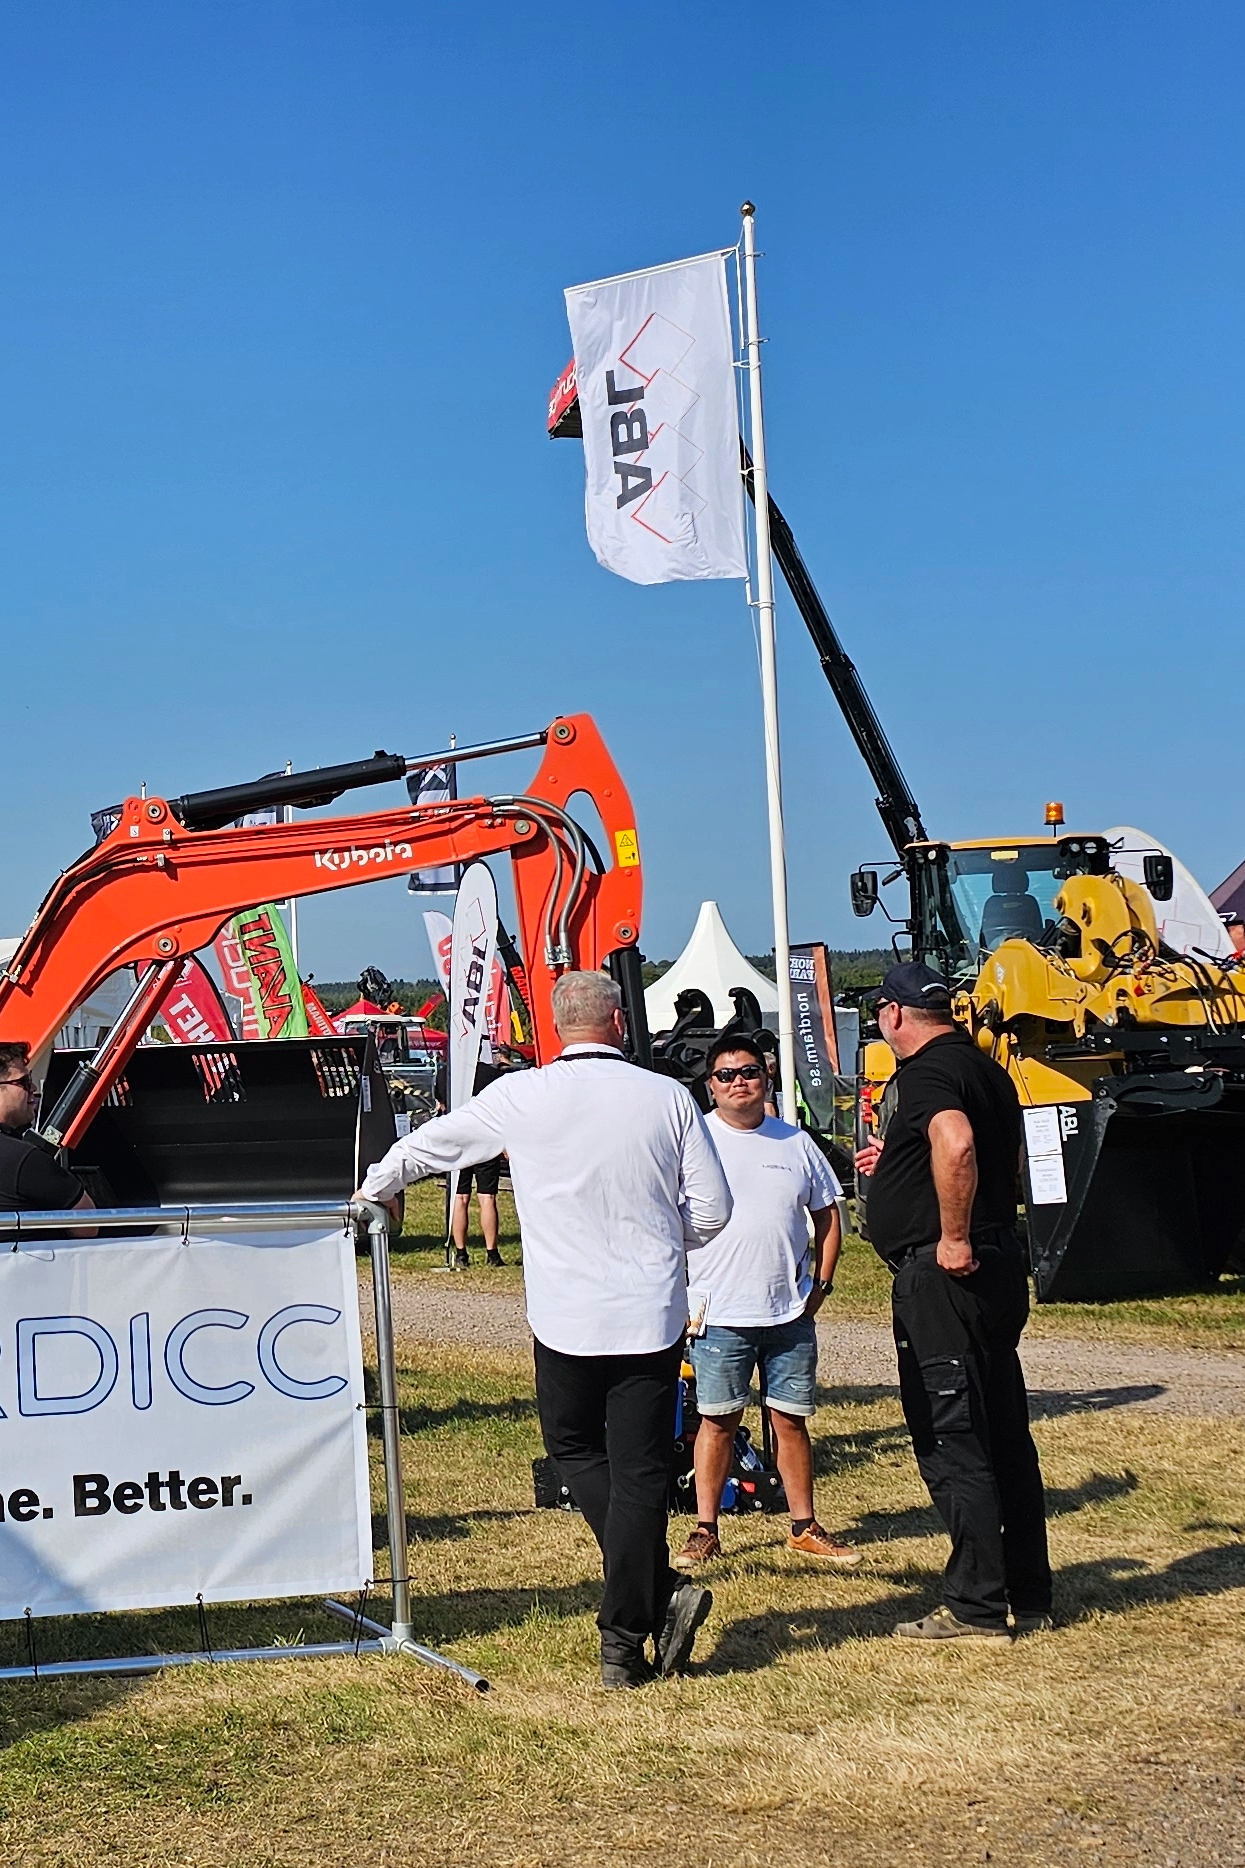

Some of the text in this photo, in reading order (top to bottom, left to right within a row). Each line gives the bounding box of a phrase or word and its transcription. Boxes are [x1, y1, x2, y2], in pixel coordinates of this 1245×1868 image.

[314, 839, 413, 871] Kubota
[462, 937, 489, 1029] ABL
[1058, 1105, 1079, 1142] ABL
[72, 1469, 254, 1518] Better.
